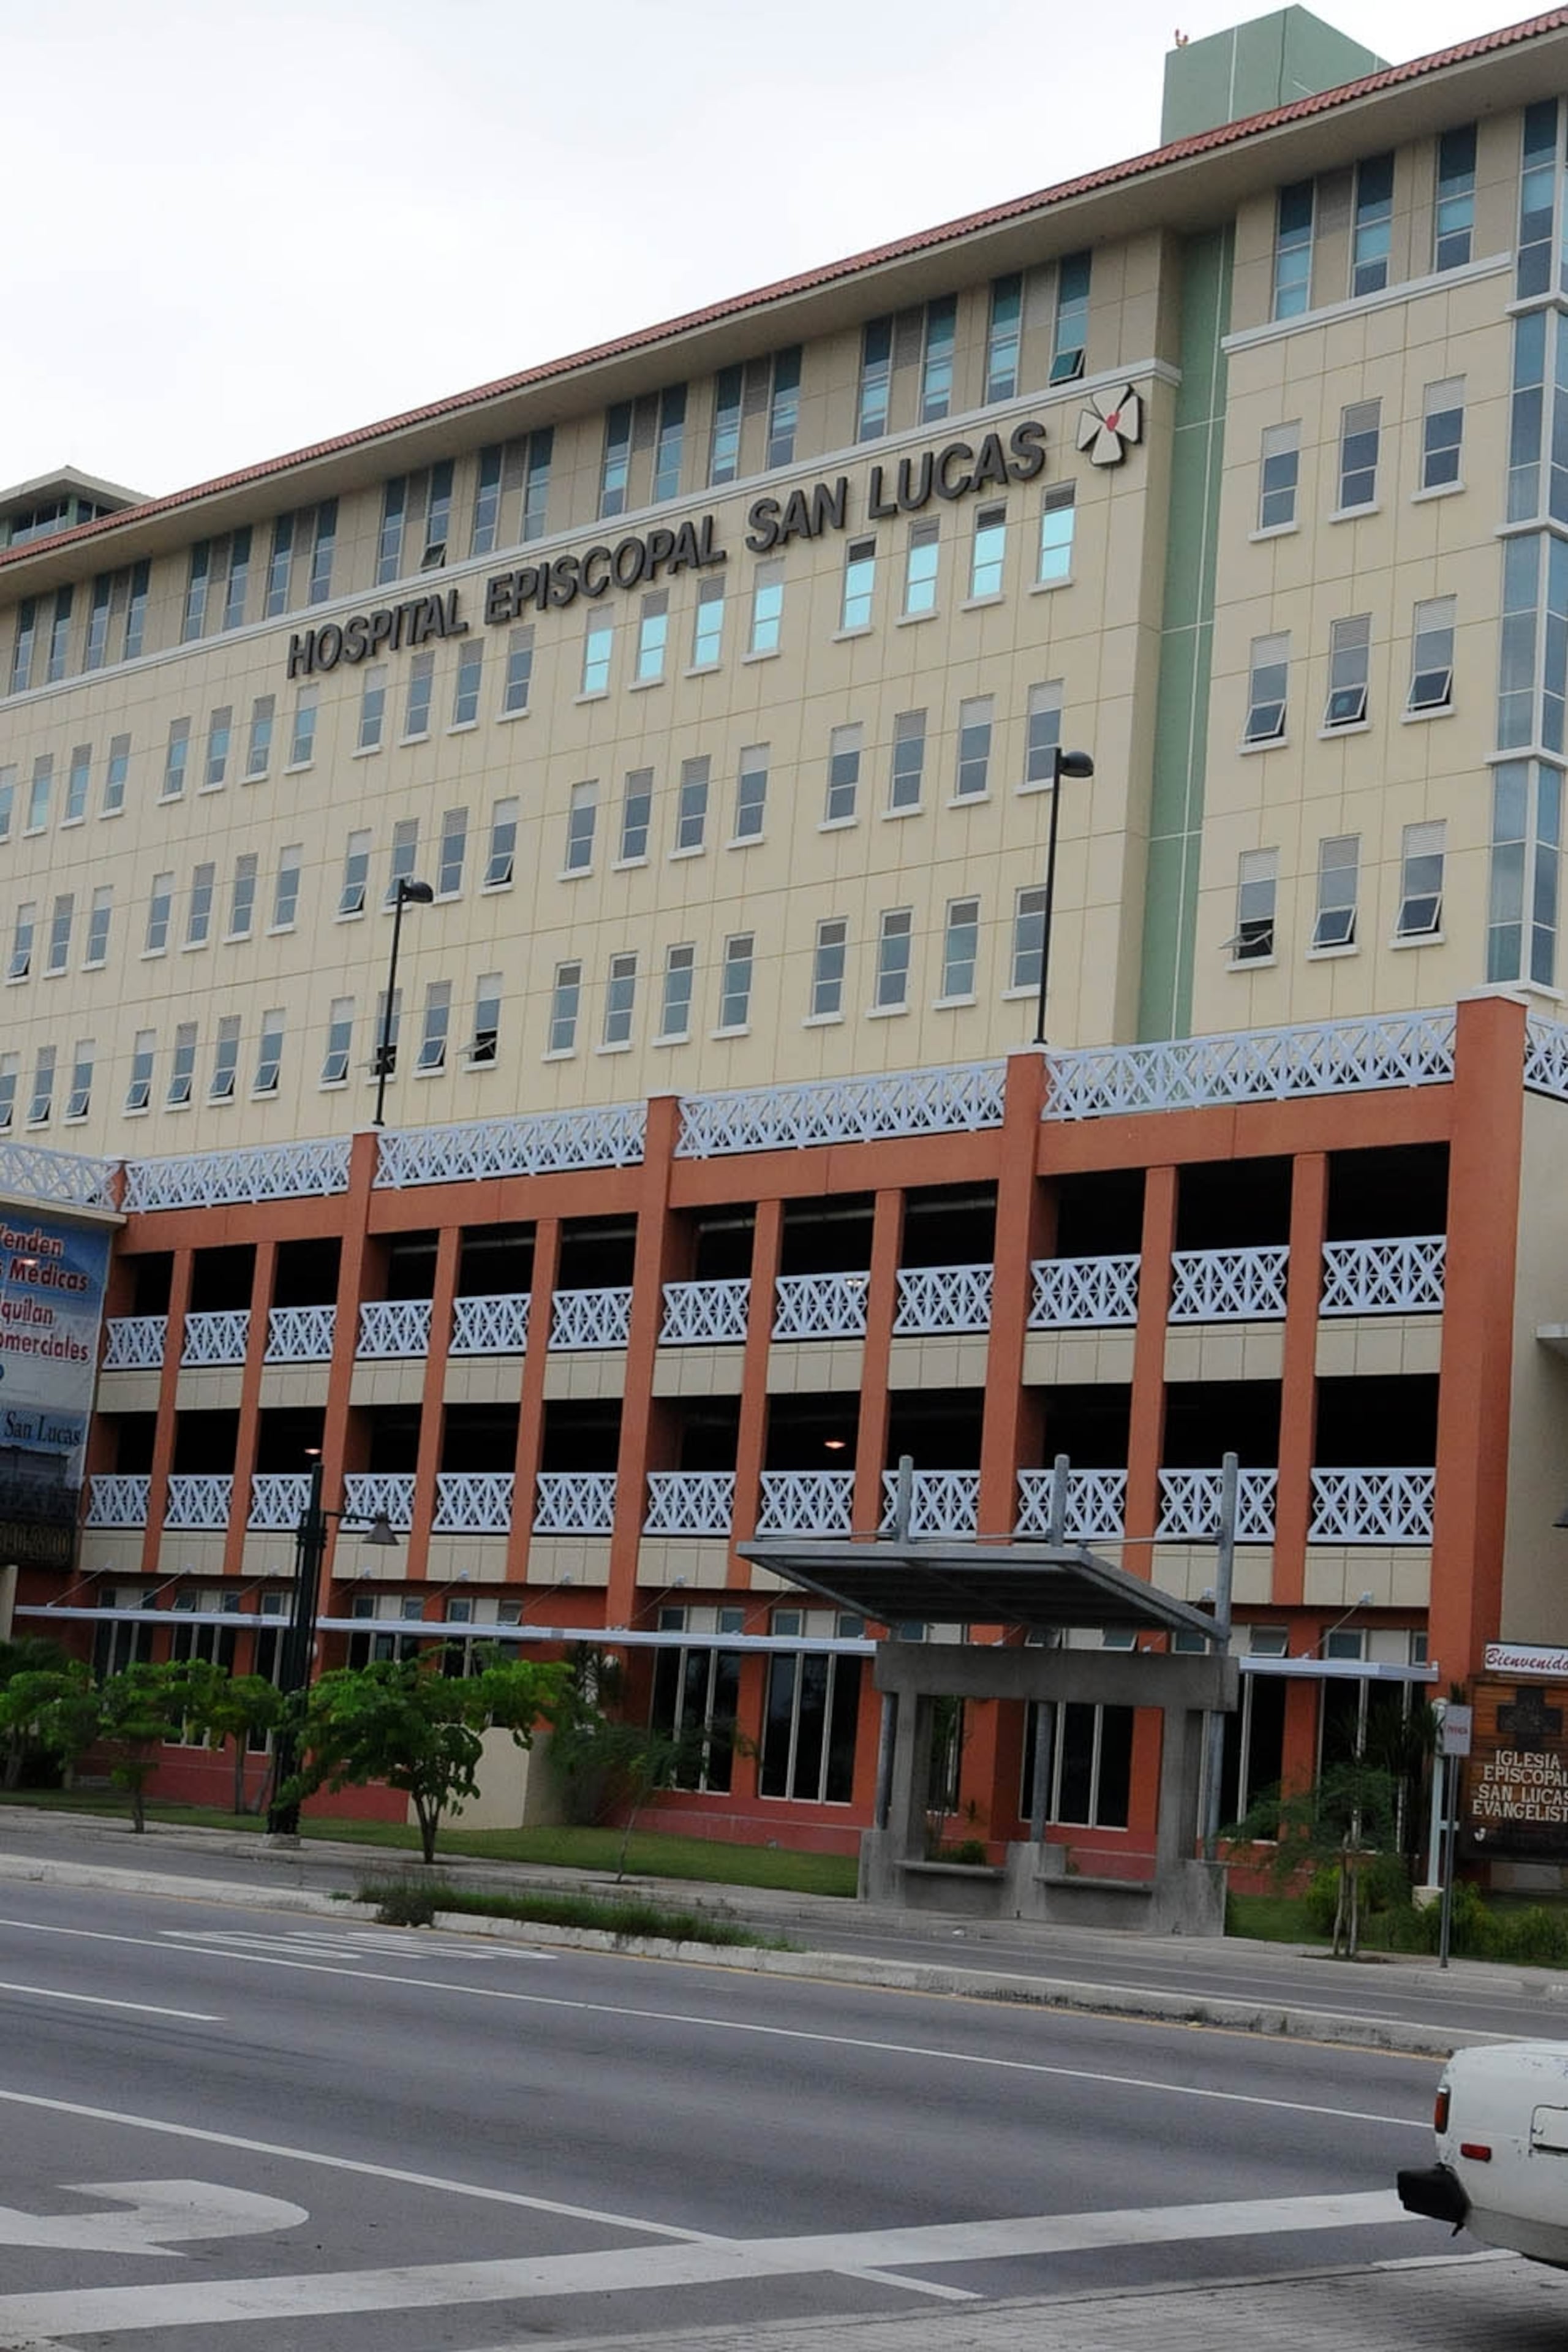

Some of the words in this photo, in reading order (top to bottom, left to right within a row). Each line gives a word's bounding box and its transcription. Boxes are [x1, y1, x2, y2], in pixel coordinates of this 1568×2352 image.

[287, 588, 469, 679] HOSPITAL
[483, 515, 728, 626] EPISCOPAL
[745, 476, 849, 553] SAN
[867, 420, 1047, 520] LUCAS
[5, 1411, 32, 1439] San
[37, 1415, 81, 1446] Lucas
[1495, 1750, 1561, 1770] IGLESIA
[1479, 1783, 1513, 1802] SAN
